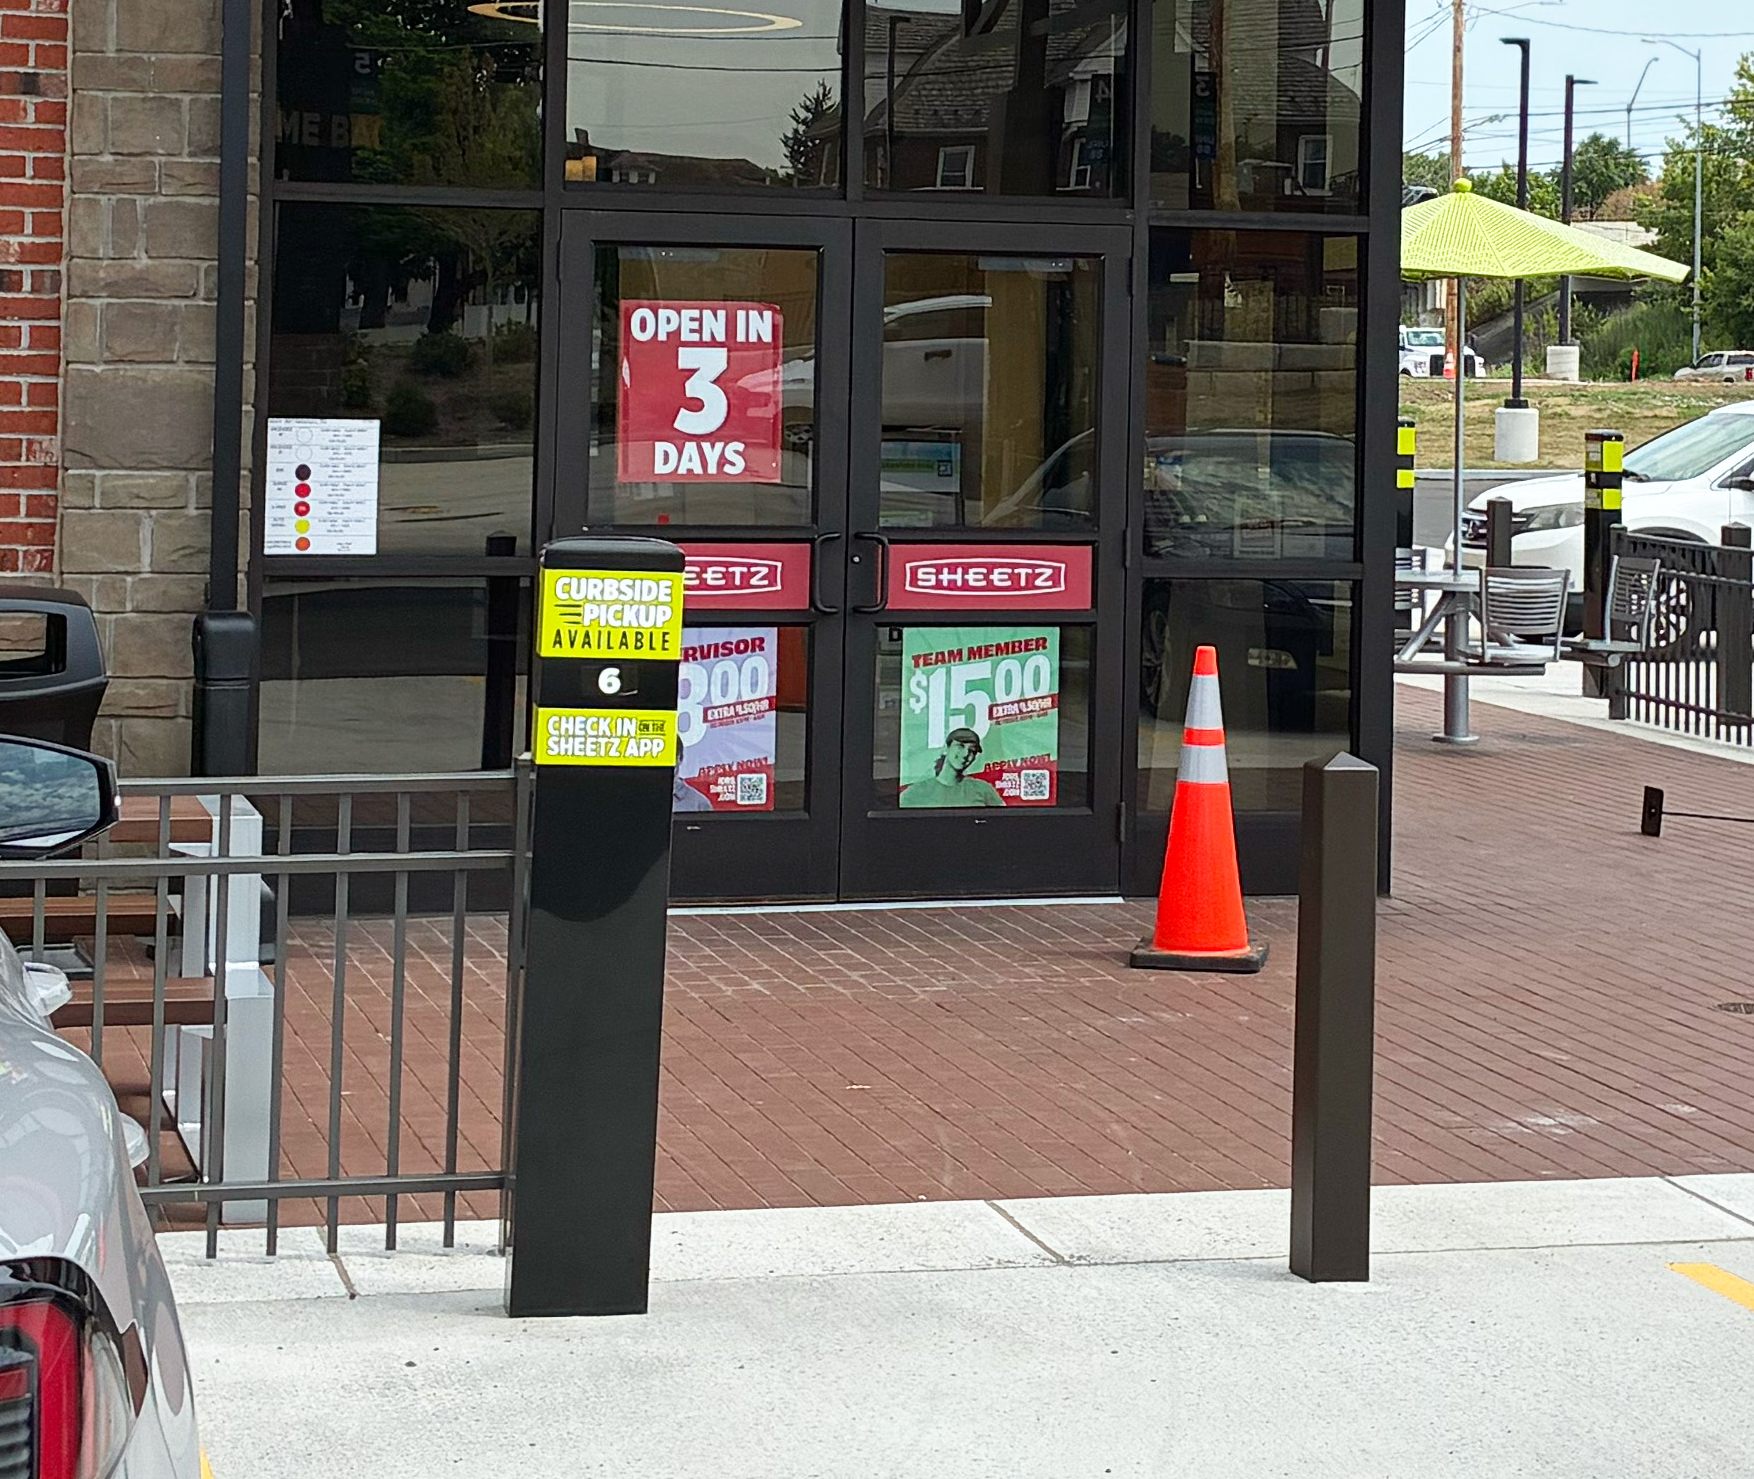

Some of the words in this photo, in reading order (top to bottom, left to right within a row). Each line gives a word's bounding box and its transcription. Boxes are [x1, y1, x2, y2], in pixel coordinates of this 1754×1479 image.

[630, 308, 726, 342] OPEN
[736, 310, 773, 343] IN
[673, 347, 729, 435] 3
[654, 441, 745, 475] DAYS
[684, 566, 769, 586] EETZ
[917, 567, 1053, 587] SHEETZ
[555, 577, 672, 602] CURBSIDE
[582, 603, 672, 628] PICKUP
[552, 628, 671, 651] AVAILABLE
[681, 636, 765, 663] RVISOR
[912, 648, 963, 668] TEAM
[967, 637, 1048, 661] MEMBER
[598, 667, 621, 694] 6
[548, 716, 611, 735] CHECK
[616, 718, 636, 737] IN
[547, 737, 621, 756] SHEETZ
[625, 738, 665, 757] APP
